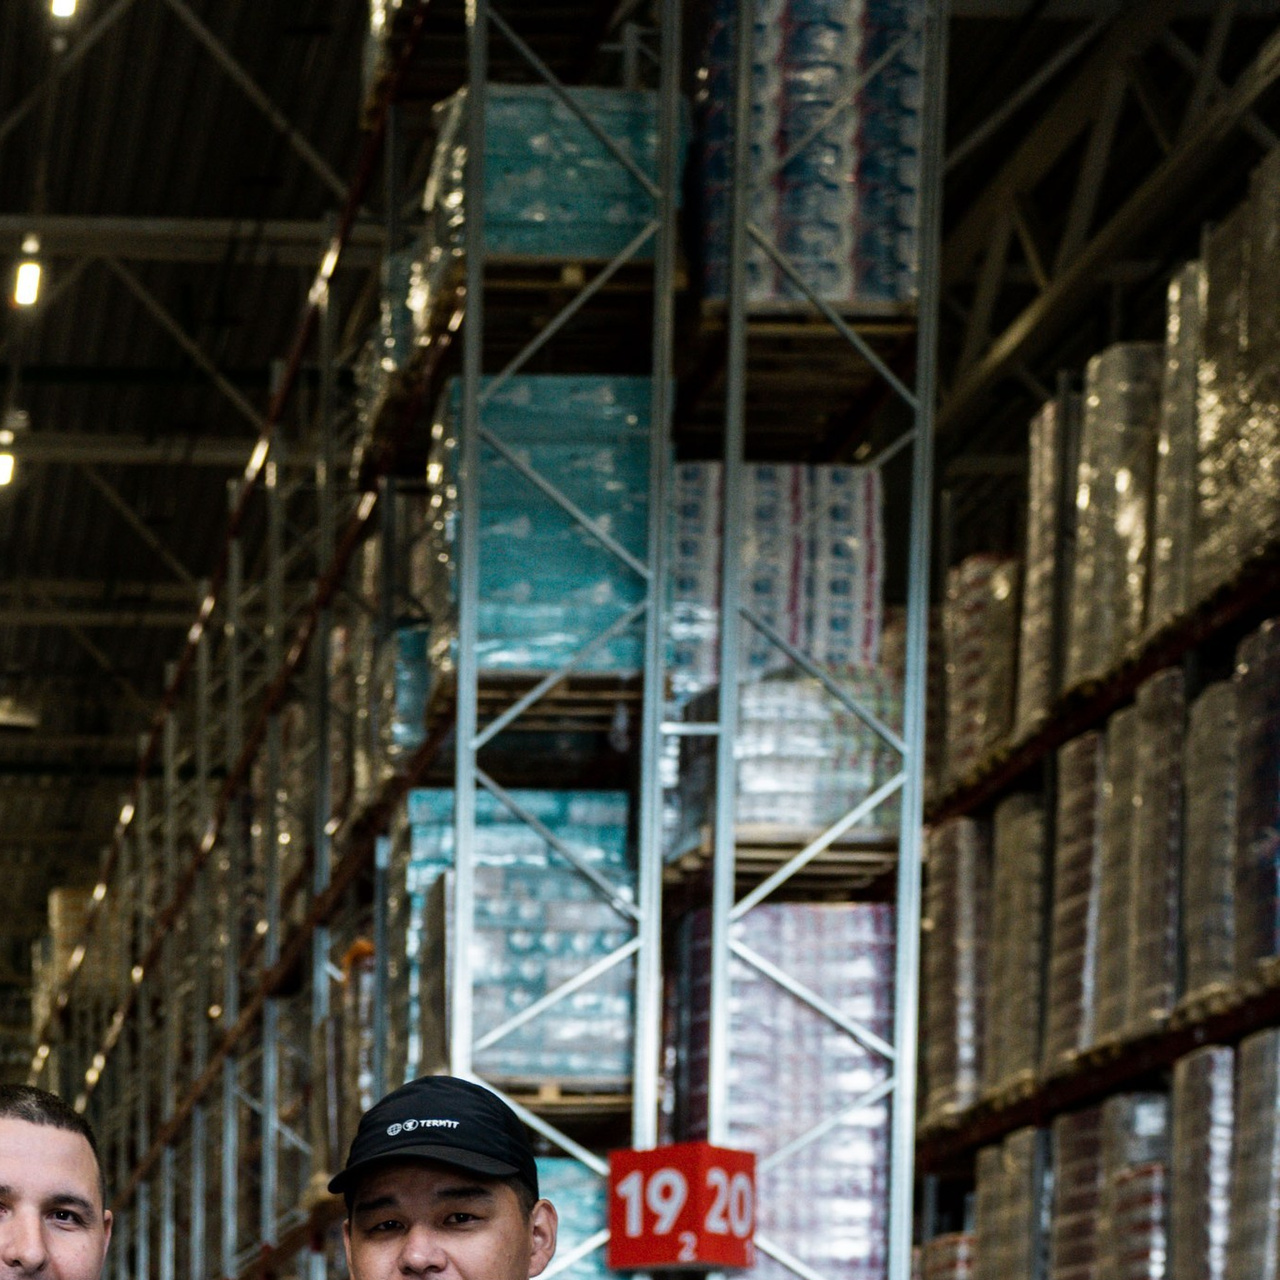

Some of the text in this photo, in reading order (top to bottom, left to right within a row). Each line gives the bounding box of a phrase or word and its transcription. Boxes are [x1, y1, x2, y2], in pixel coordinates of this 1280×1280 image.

[616, 1167, 688, 1237] 19
[704, 1166, 752, 1238] 20
[677, 1231, 697, 1262] 2
